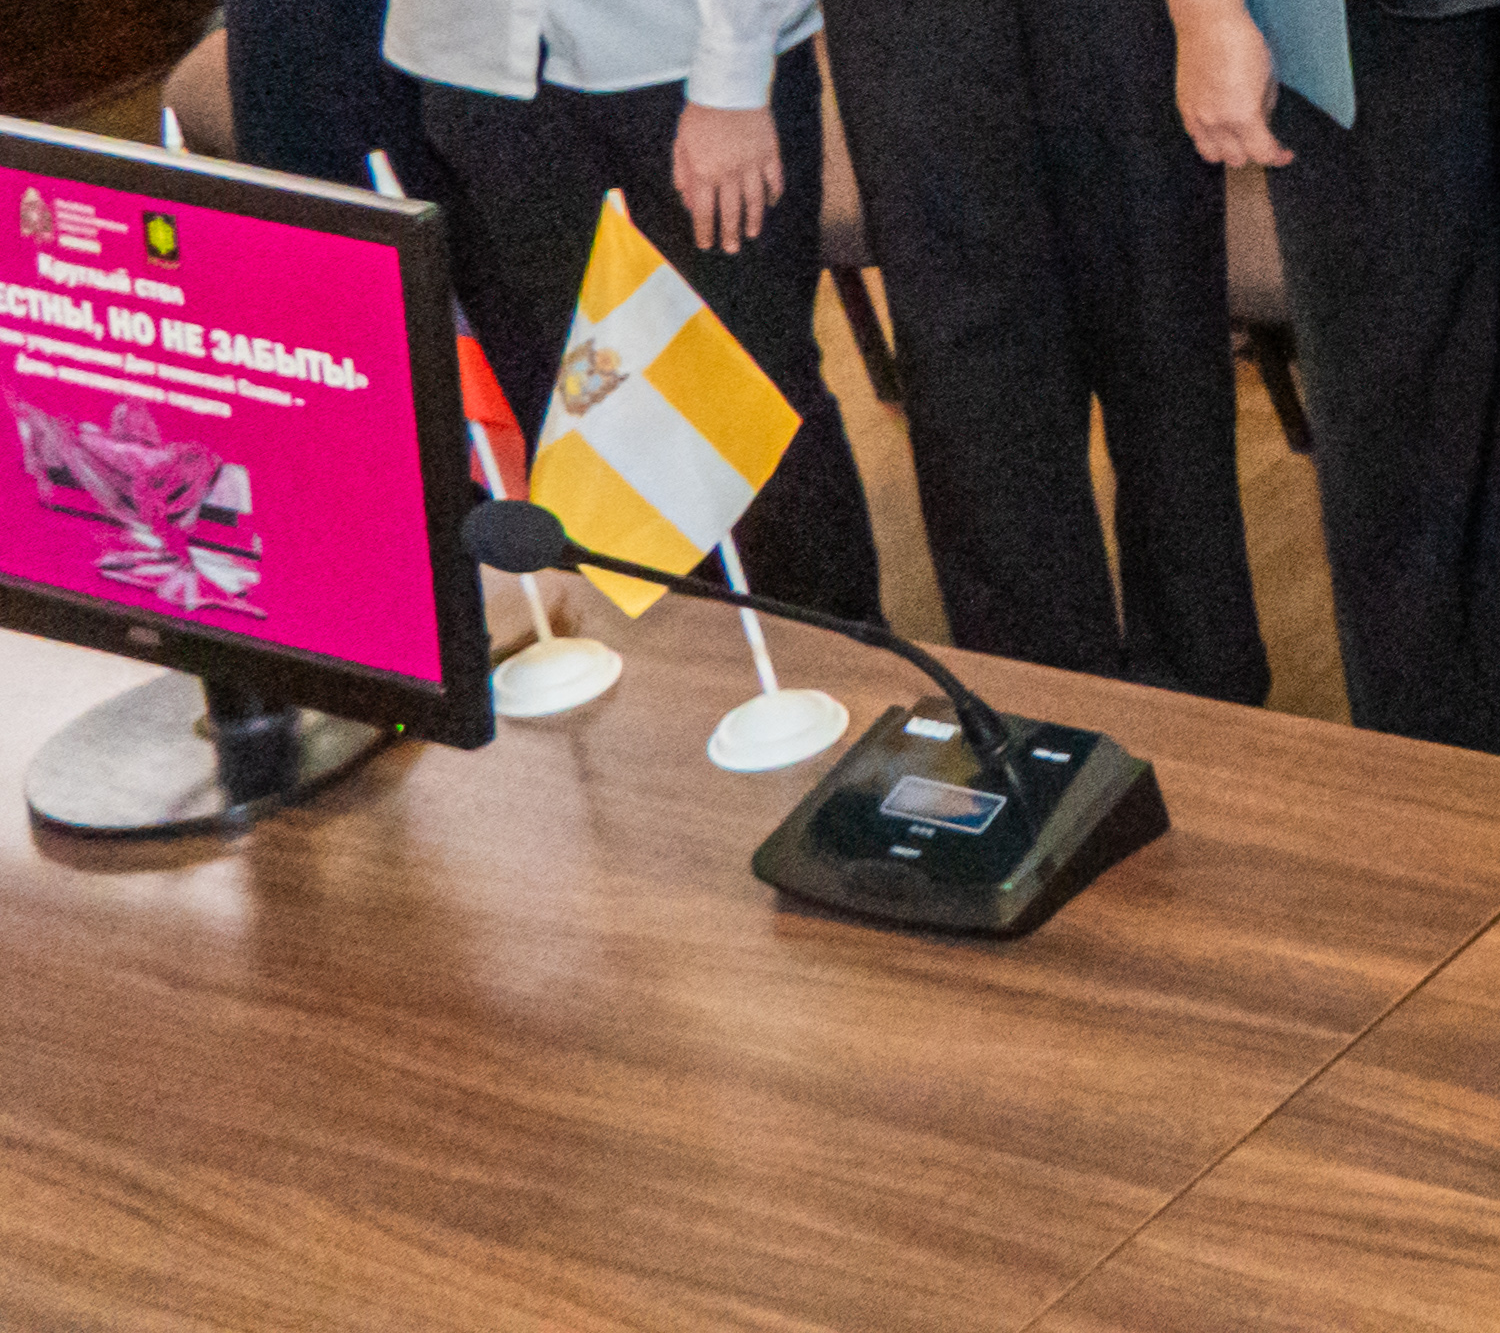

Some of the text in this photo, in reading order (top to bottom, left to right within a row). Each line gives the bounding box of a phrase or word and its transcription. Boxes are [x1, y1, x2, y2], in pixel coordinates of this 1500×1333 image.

[37, 252, 131, 294] Круглый
[107, 305, 156, 346] НО
[161, 317, 207, 358] НЕ
[208, 328, 369, 391] ЗАБЫТЫ»
